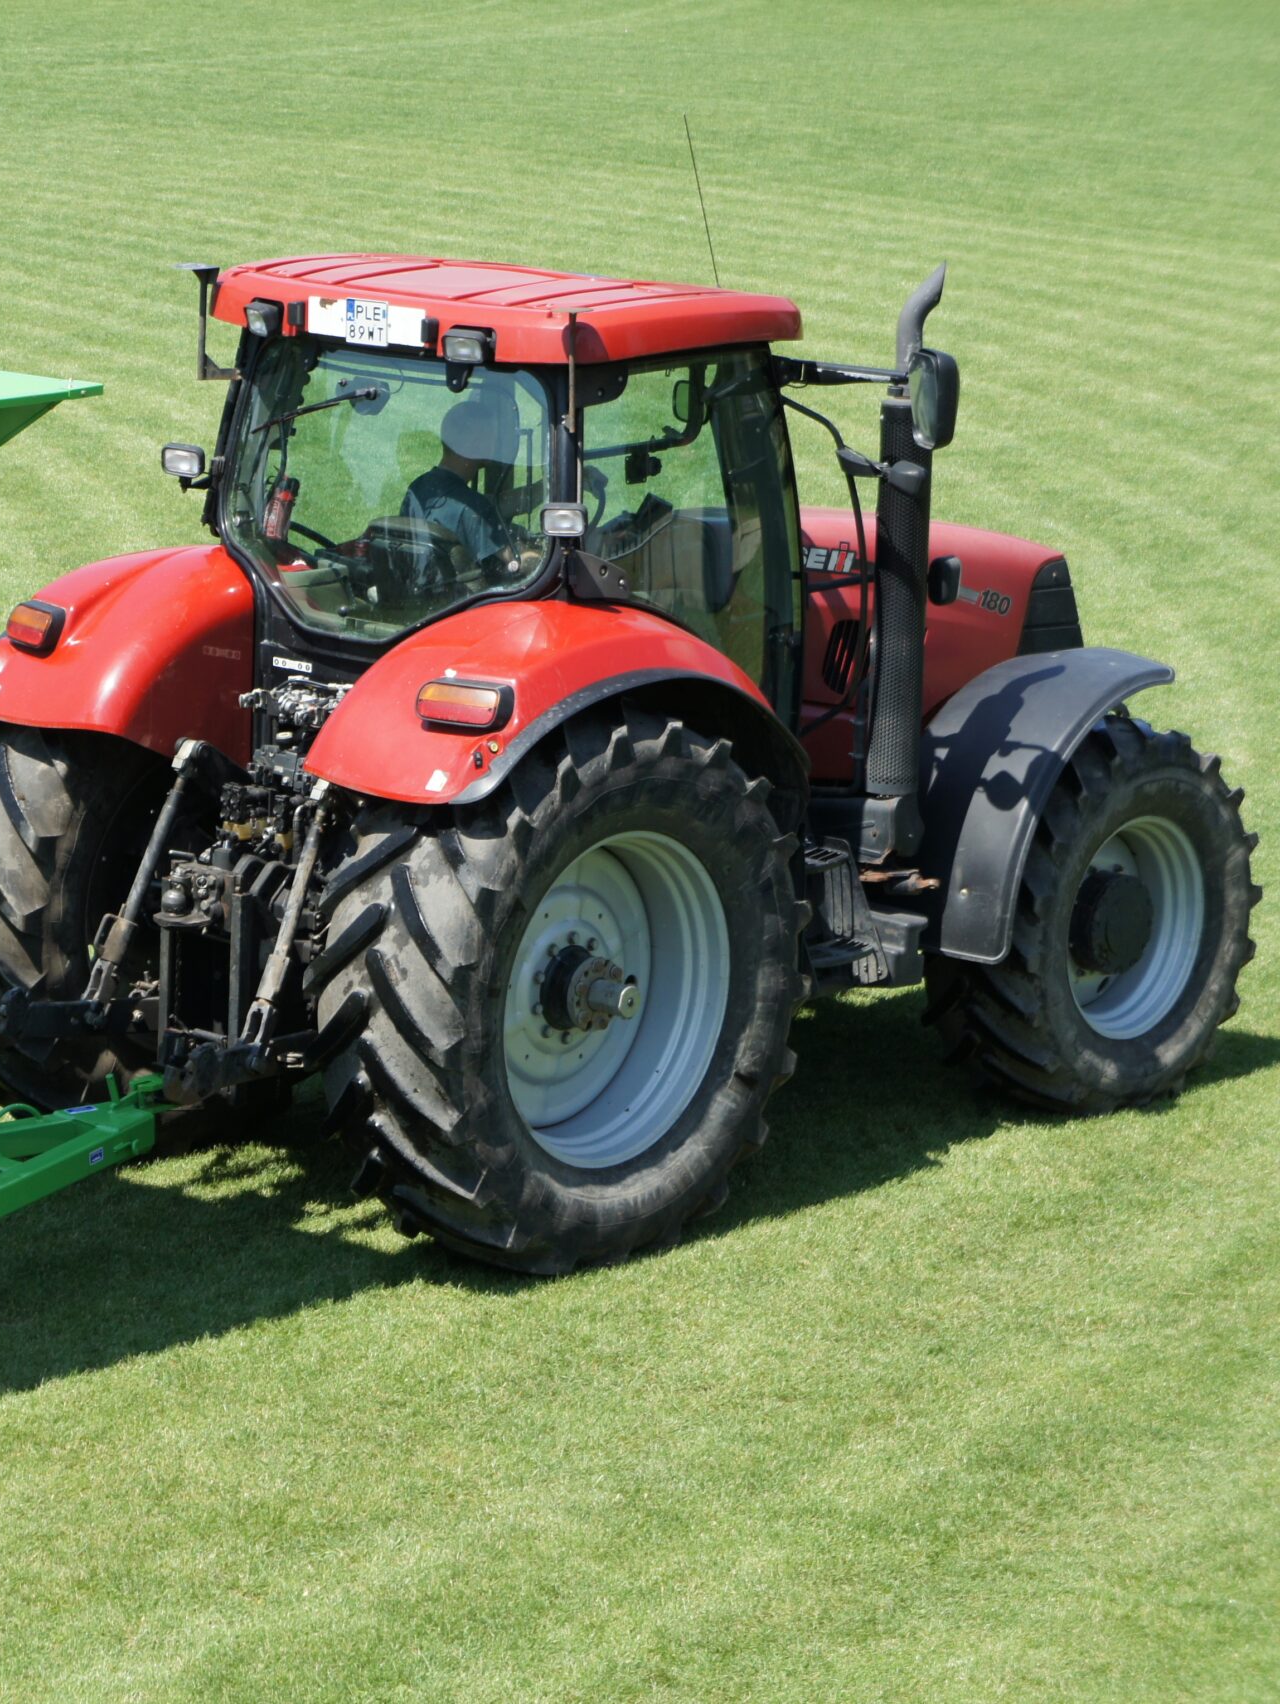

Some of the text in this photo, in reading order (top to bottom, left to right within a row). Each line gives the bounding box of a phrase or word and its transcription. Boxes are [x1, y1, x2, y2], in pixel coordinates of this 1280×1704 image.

[356, 305, 381, 321] PLE
[349, 324, 384, 342] 89WT
[979, 588, 1011, 616] 180
